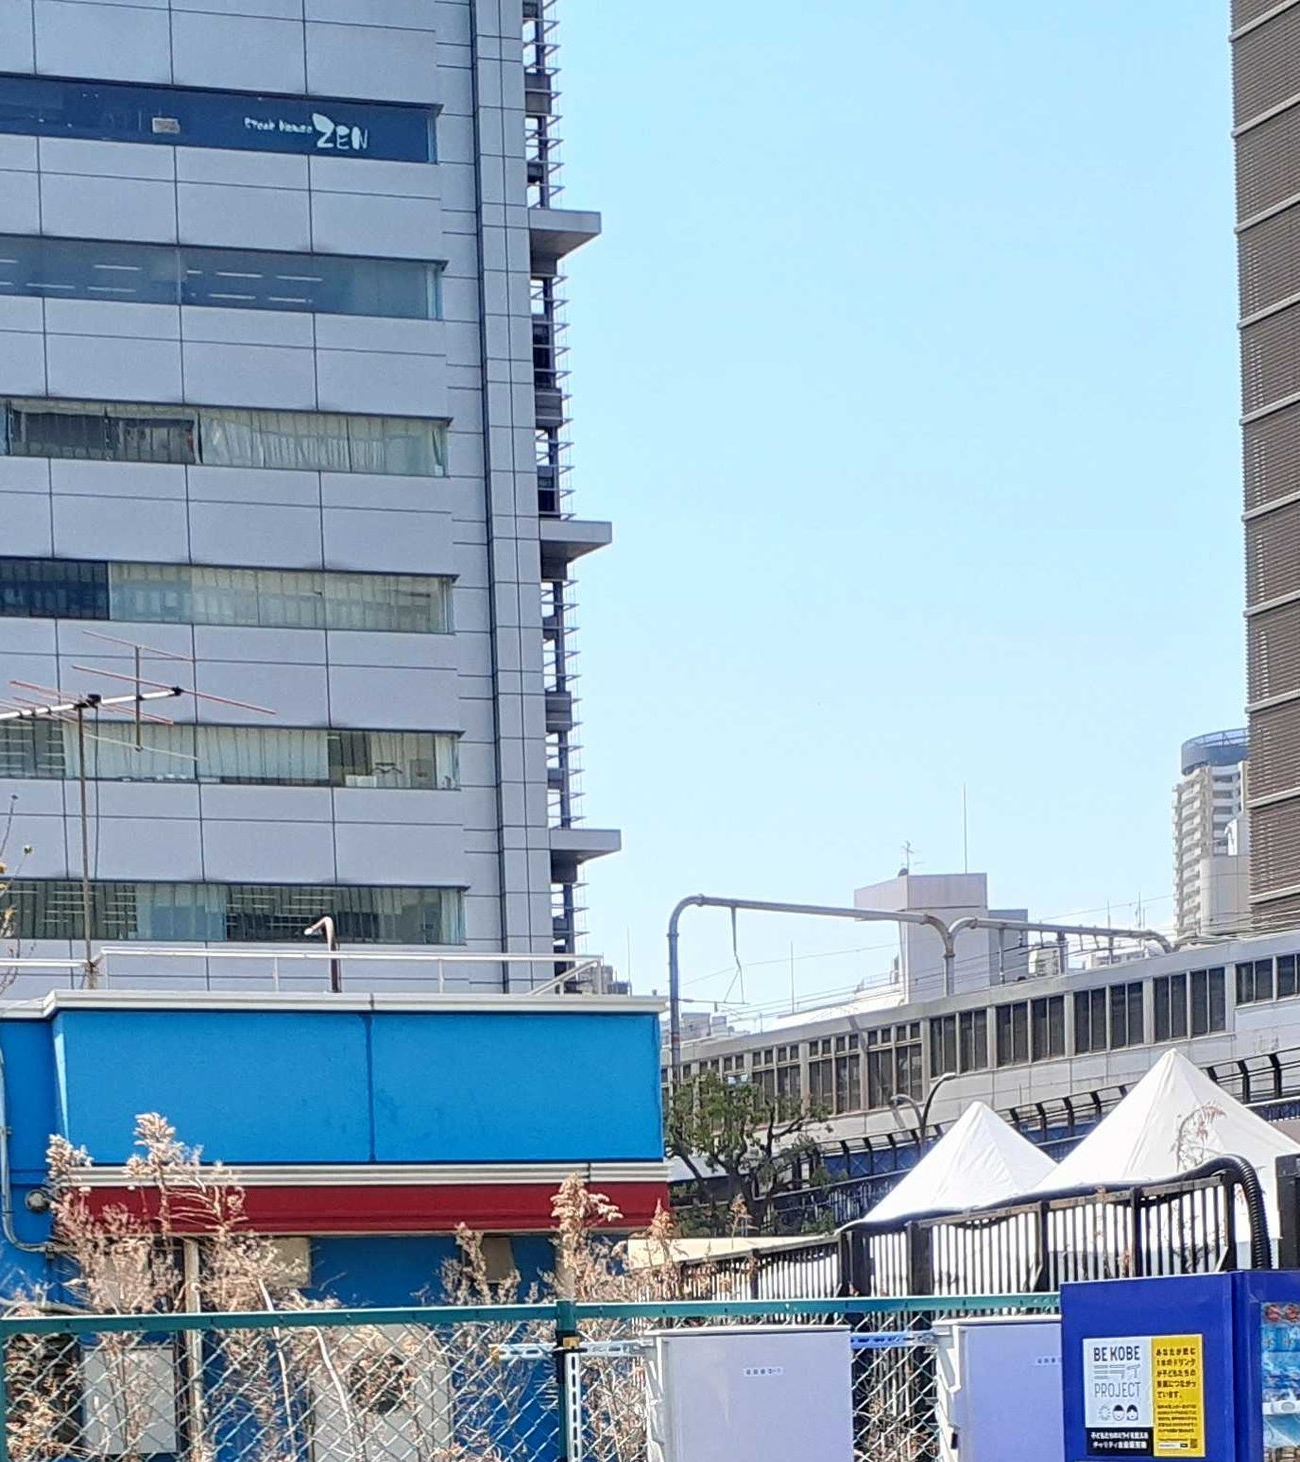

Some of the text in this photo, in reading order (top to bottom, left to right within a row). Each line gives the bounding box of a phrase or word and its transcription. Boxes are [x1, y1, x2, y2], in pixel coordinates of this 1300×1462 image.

[312, 112, 368, 150] ZEN
[1094, 1345, 1140, 1361] BE KOBE
[1094, 1364, 1141, 1380] ミライ
[1094, 1382, 1141, 1398] PROJECT
